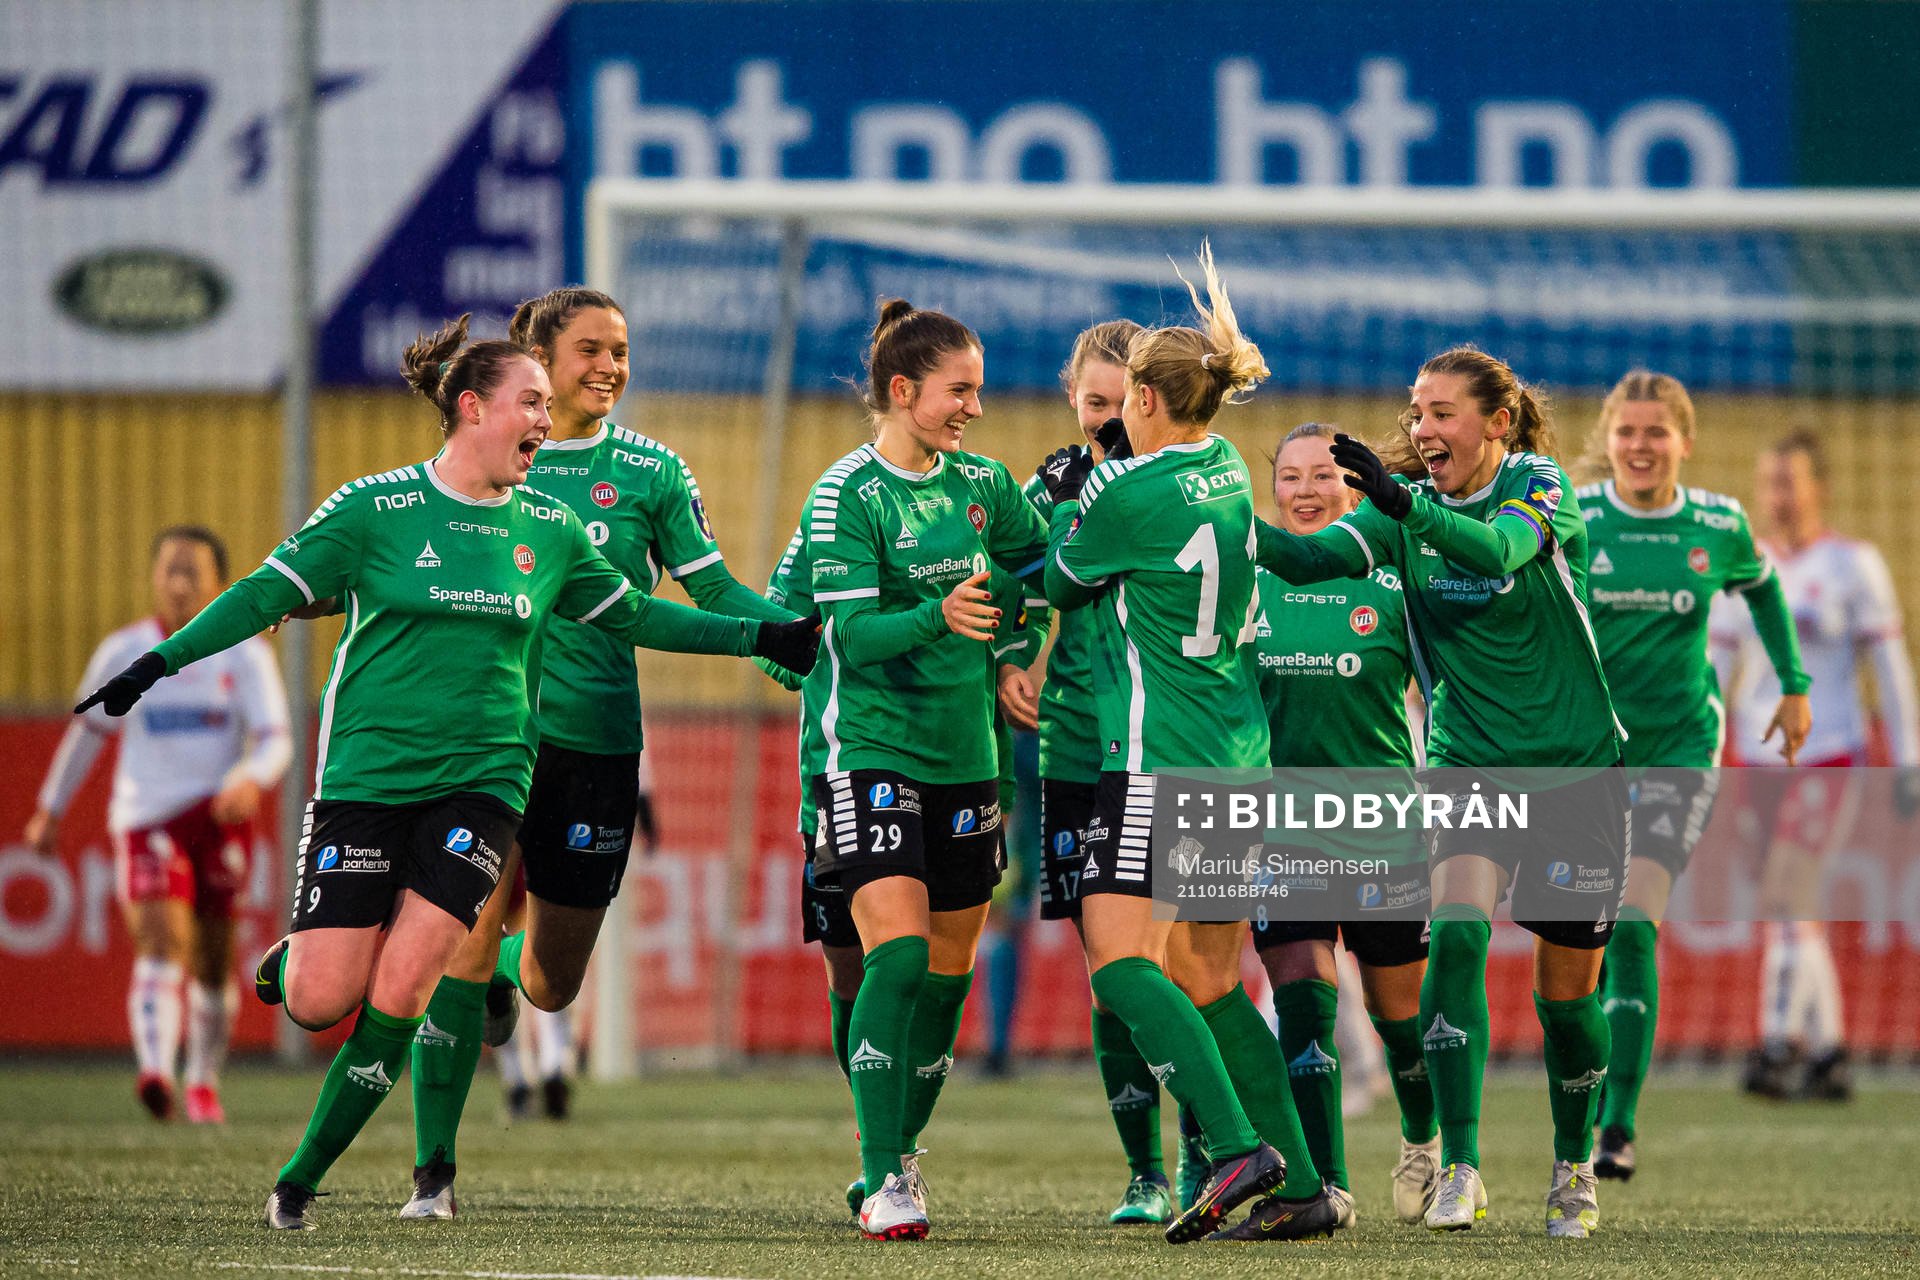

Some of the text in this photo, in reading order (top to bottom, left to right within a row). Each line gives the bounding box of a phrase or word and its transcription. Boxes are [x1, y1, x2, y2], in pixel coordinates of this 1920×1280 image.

[895, 539, 919, 550] SELECT
[1420, 547, 1441, 557] SELEC
[415, 559, 442, 568] SELECT
[908, 556, 971, 579] SpareBank
[429, 586, 512, 606] SpareBank
[451, 603, 513, 616] NORD-NORGE
[1357, 614, 1372, 625] TIL
[1257, 629, 1273, 638] LECT
[1258, 652, 1334, 668] SpareBank
[1275, 668, 1334, 676] NORD-NORGE
[869, 824, 902, 852] 29
[343, 845, 382, 857] Tromsø
[343, 859, 390, 872] parkering
[1059, 870, 1080, 901] 17
[307, 886, 322, 914] 9
[1257, 905, 1268, 931] 8
[851, 1062, 893, 1073] SELECT
